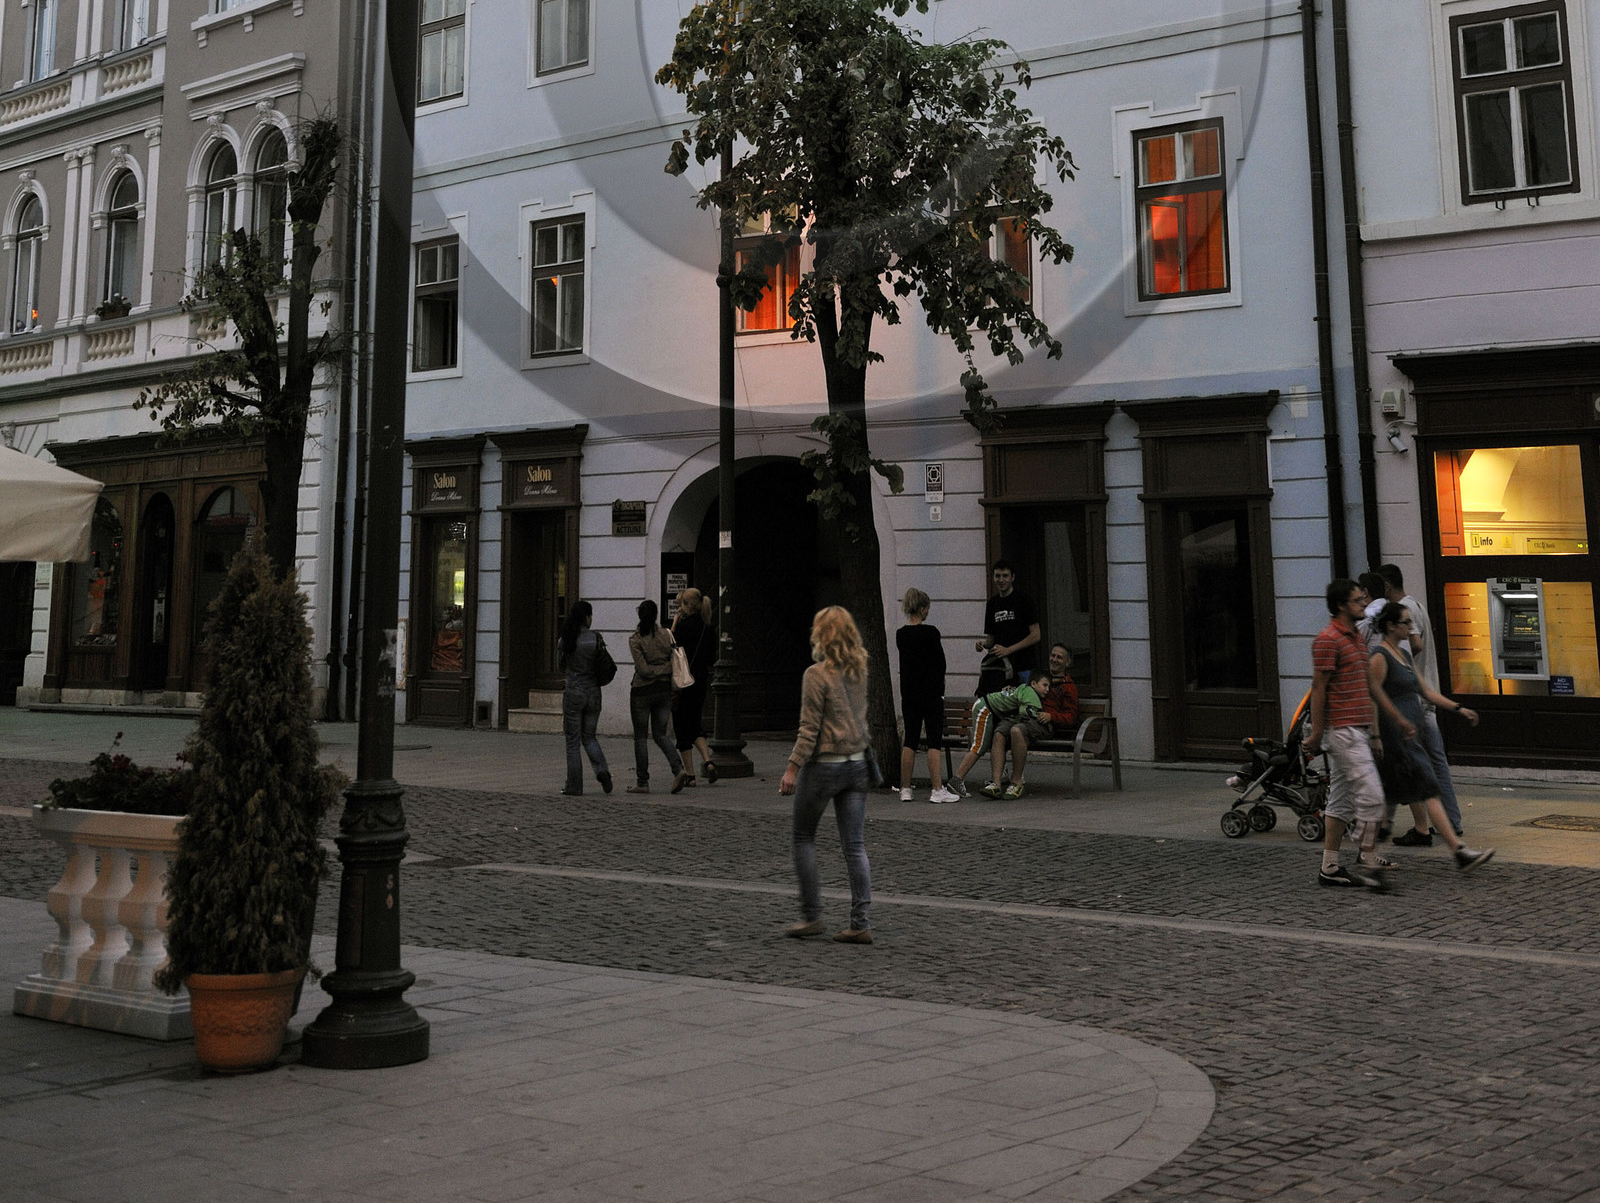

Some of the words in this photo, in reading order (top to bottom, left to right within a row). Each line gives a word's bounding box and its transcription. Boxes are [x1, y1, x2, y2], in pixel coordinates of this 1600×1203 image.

[433, 472, 456, 489] Salon
[527, 465, 552, 483] Salon
[1479, 536, 1493, 546] info
